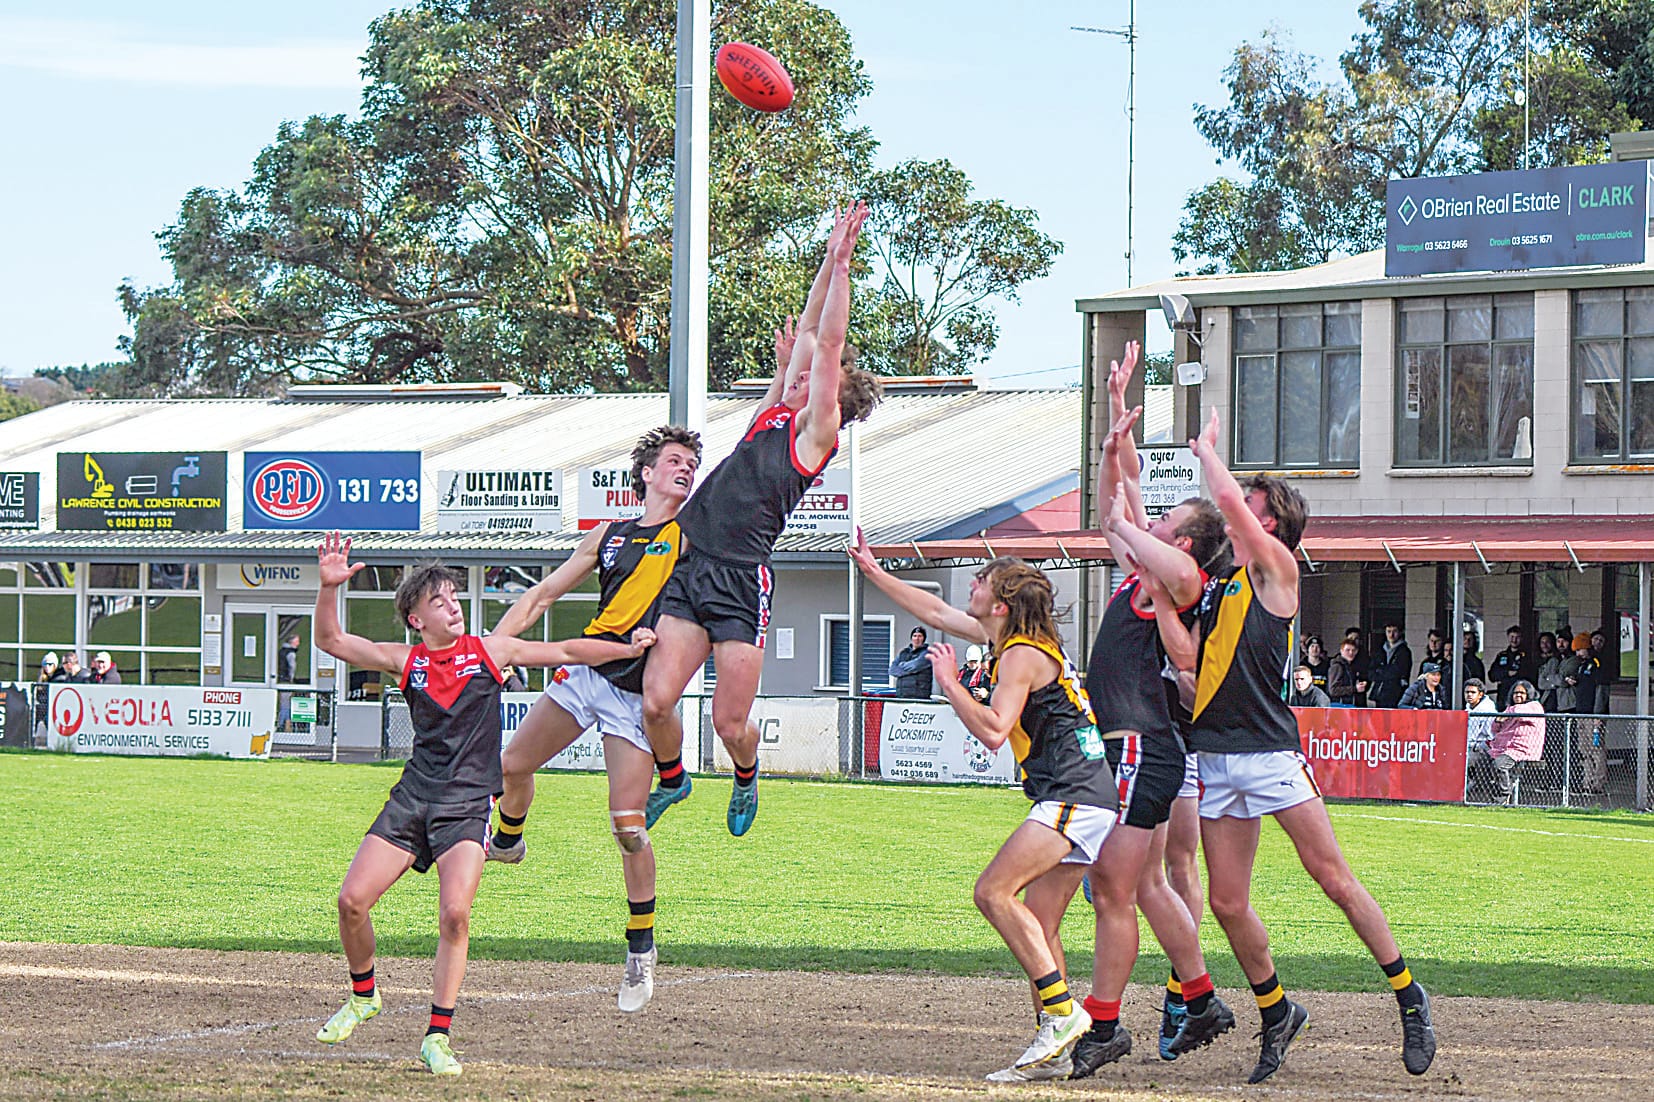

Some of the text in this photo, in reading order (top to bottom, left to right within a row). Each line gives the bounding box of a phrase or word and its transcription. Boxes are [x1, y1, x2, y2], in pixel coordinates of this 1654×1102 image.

[726, 52, 778, 96] SHERRIN
[1421, 185, 1634, 219] OBrien Real Estate CLARK
[1424, 241, 1434, 251] 03
[1434, 240, 1451, 250] 5623
[1511, 236, 1521, 246] 03
[1521, 235, 1538, 245] 5625
[1539, 234, 1553, 244] 1671
[1150, 452, 1175, 464] ayres
[592, 470, 617, 488] S&F
[1149, 465, 1193, 481] plumbing
[261, 468, 319, 506] PFD
[466, 472, 553, 492] ULTIMATE
[338, 479, 418, 502] 131 733
[62, 498, 220, 509] LAWRENCE CIVIL CONSTRUCTION
[461, 493, 559, 507] Floor Sanding & Laying
[1151, 494, 1160, 504] 221
[116, 518, 173, 528] 0438 023 532
[487, 517, 533, 529] 0419234424
[254, 566, 300, 580] WIFNC
[205, 691, 240, 704] PHONE
[89, 698, 174, 728] VEOLIA
[187, 709, 252, 728] 5133 7111
[900, 708, 936, 725] SPEEDY
[77, 733, 209, 749] ENVIRONMENTAL SERVICES
[888, 724, 945, 742] LOCKSMITHS
[1308, 730, 1437, 768] hockingstuart
[895, 760, 933, 769] 5623 4569
[890, 769, 909, 778] 0412
[925, 770, 939, 779] 689
